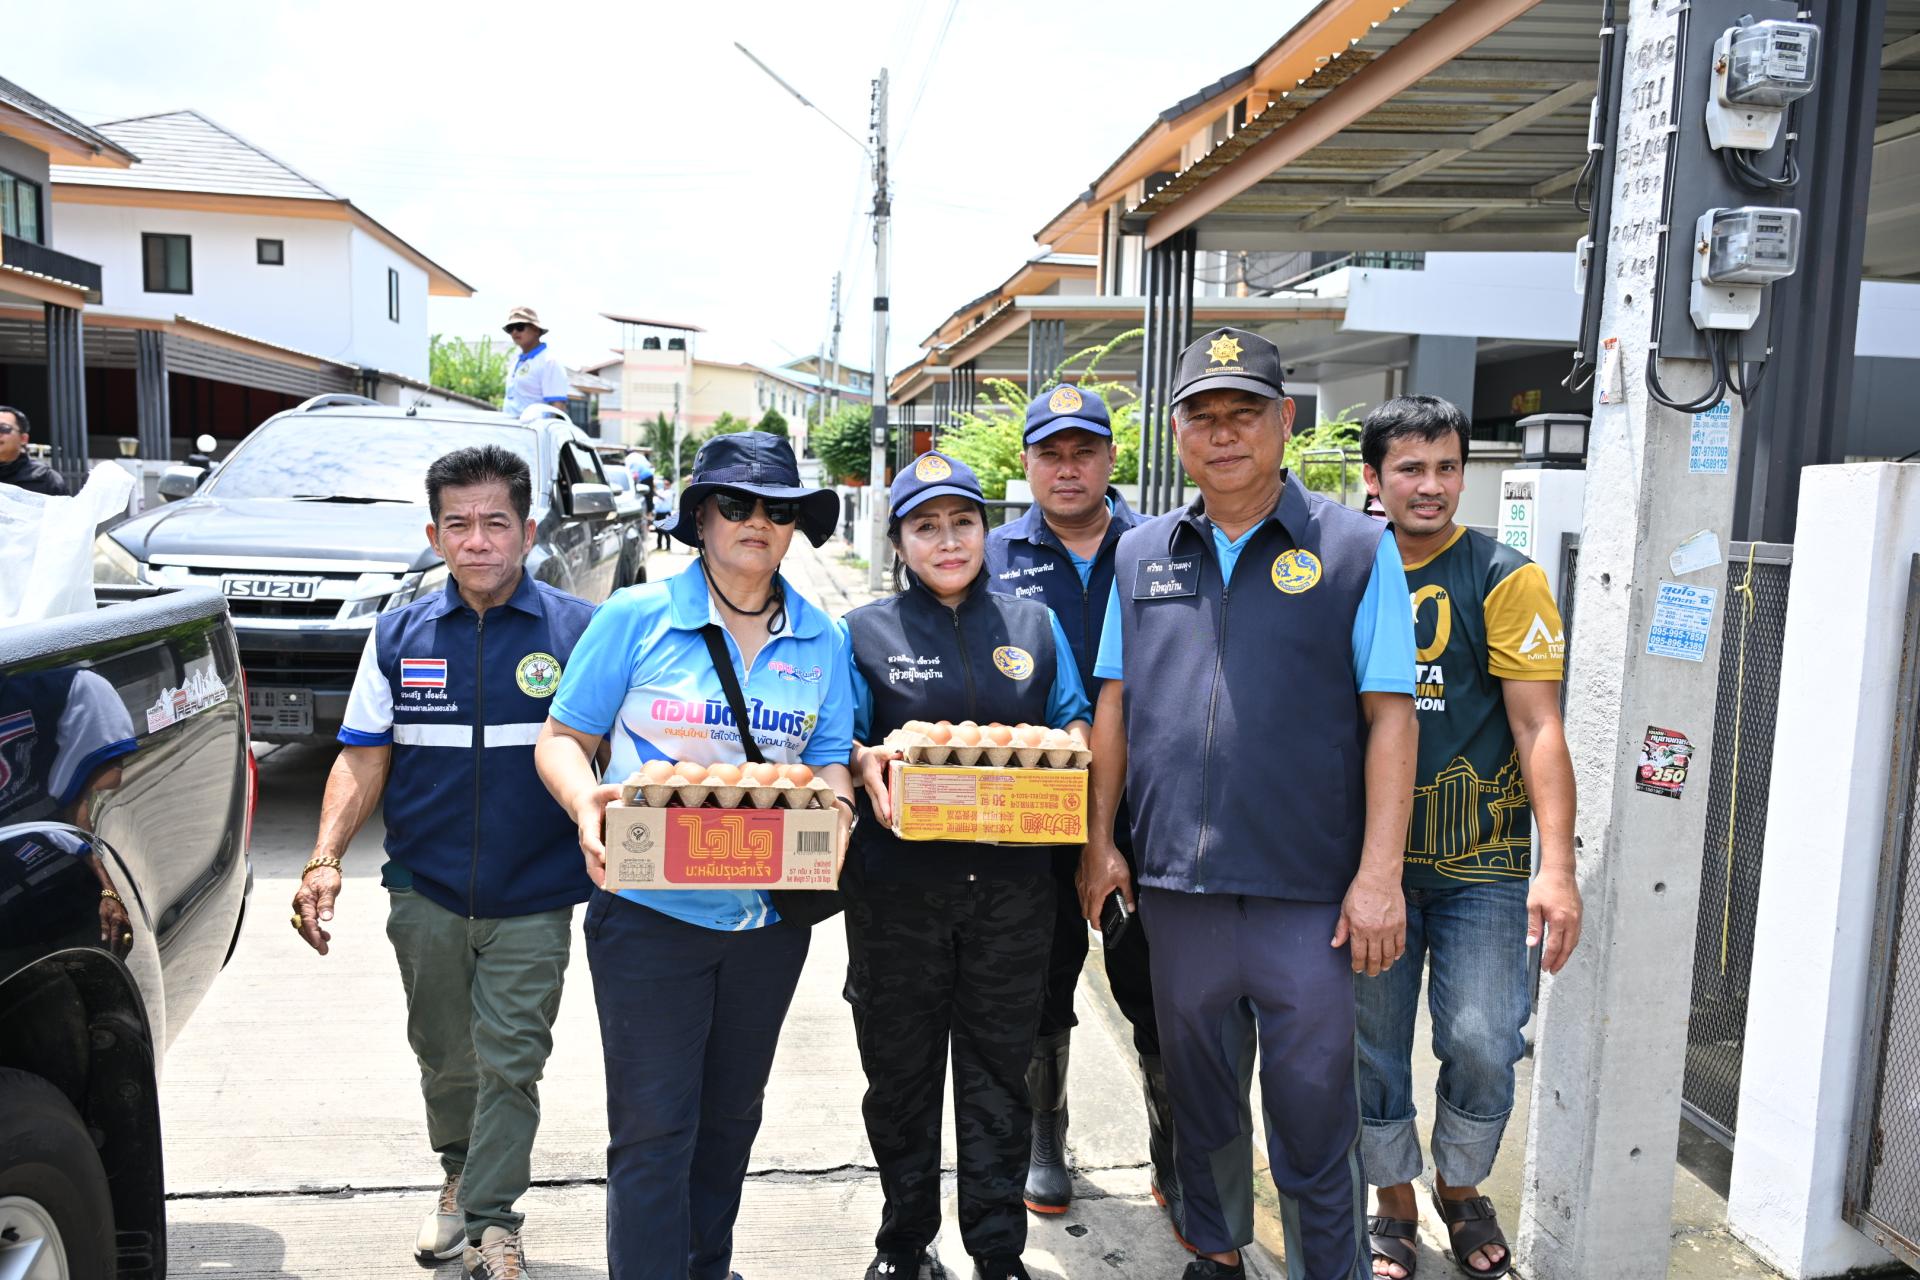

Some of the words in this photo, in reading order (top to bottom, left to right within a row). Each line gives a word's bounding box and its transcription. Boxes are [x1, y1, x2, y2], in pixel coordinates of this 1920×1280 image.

[1511, 504, 1525, 521] 96
[1505, 531, 1527, 548] 223
[224, 580, 311, 598] ISUZU
[1651, 767, 1686, 783] 350
[677, 815, 772, 859] ไวไว
